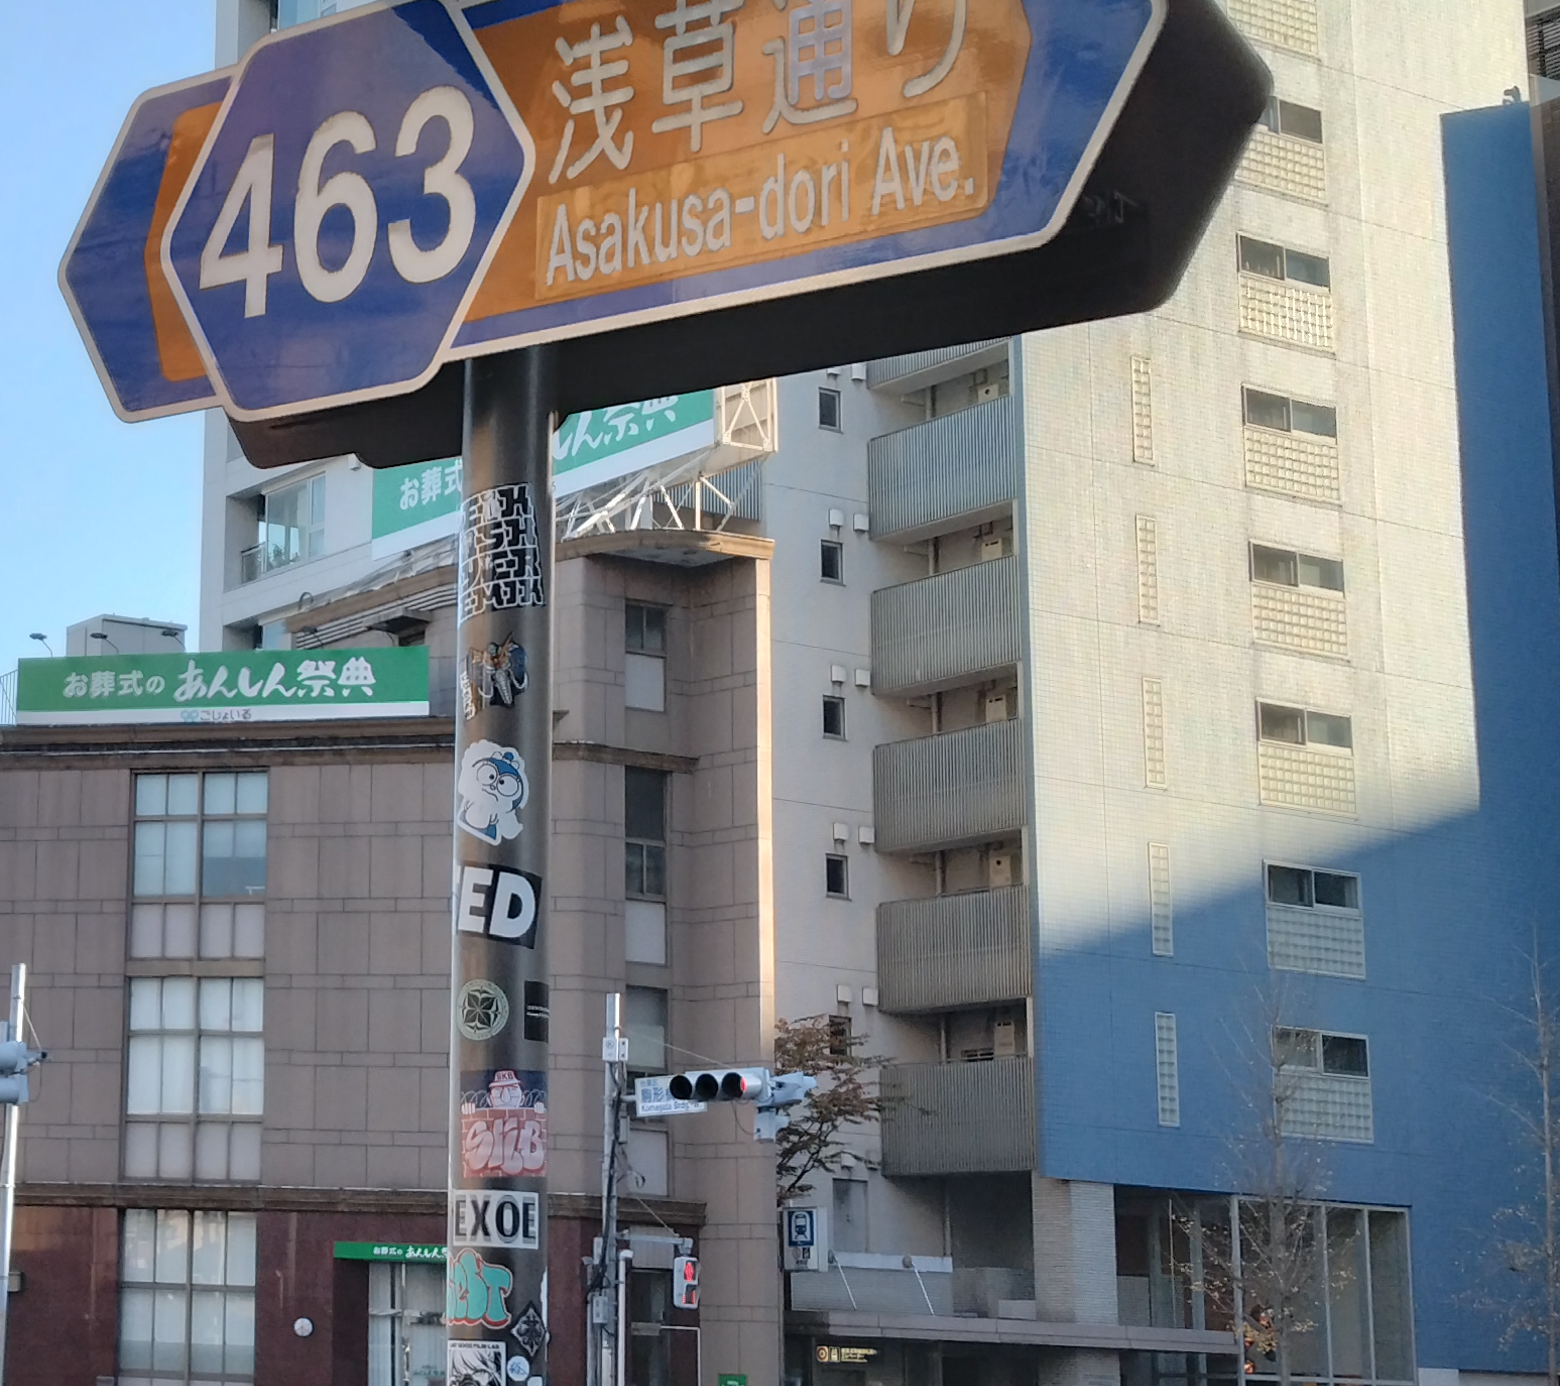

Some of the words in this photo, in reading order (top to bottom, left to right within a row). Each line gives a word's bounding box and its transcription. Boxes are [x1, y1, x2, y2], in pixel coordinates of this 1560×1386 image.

[198, 83, 477, 320] 463
[544, 145, 852, 289] Asakusa-dori
[872, 128, 976, 212] Ave.
[62, 669, 166, 699] お葬式の
[173, 656, 377, 703] あんしん祭典
[453, 865, 536, 938] ED
